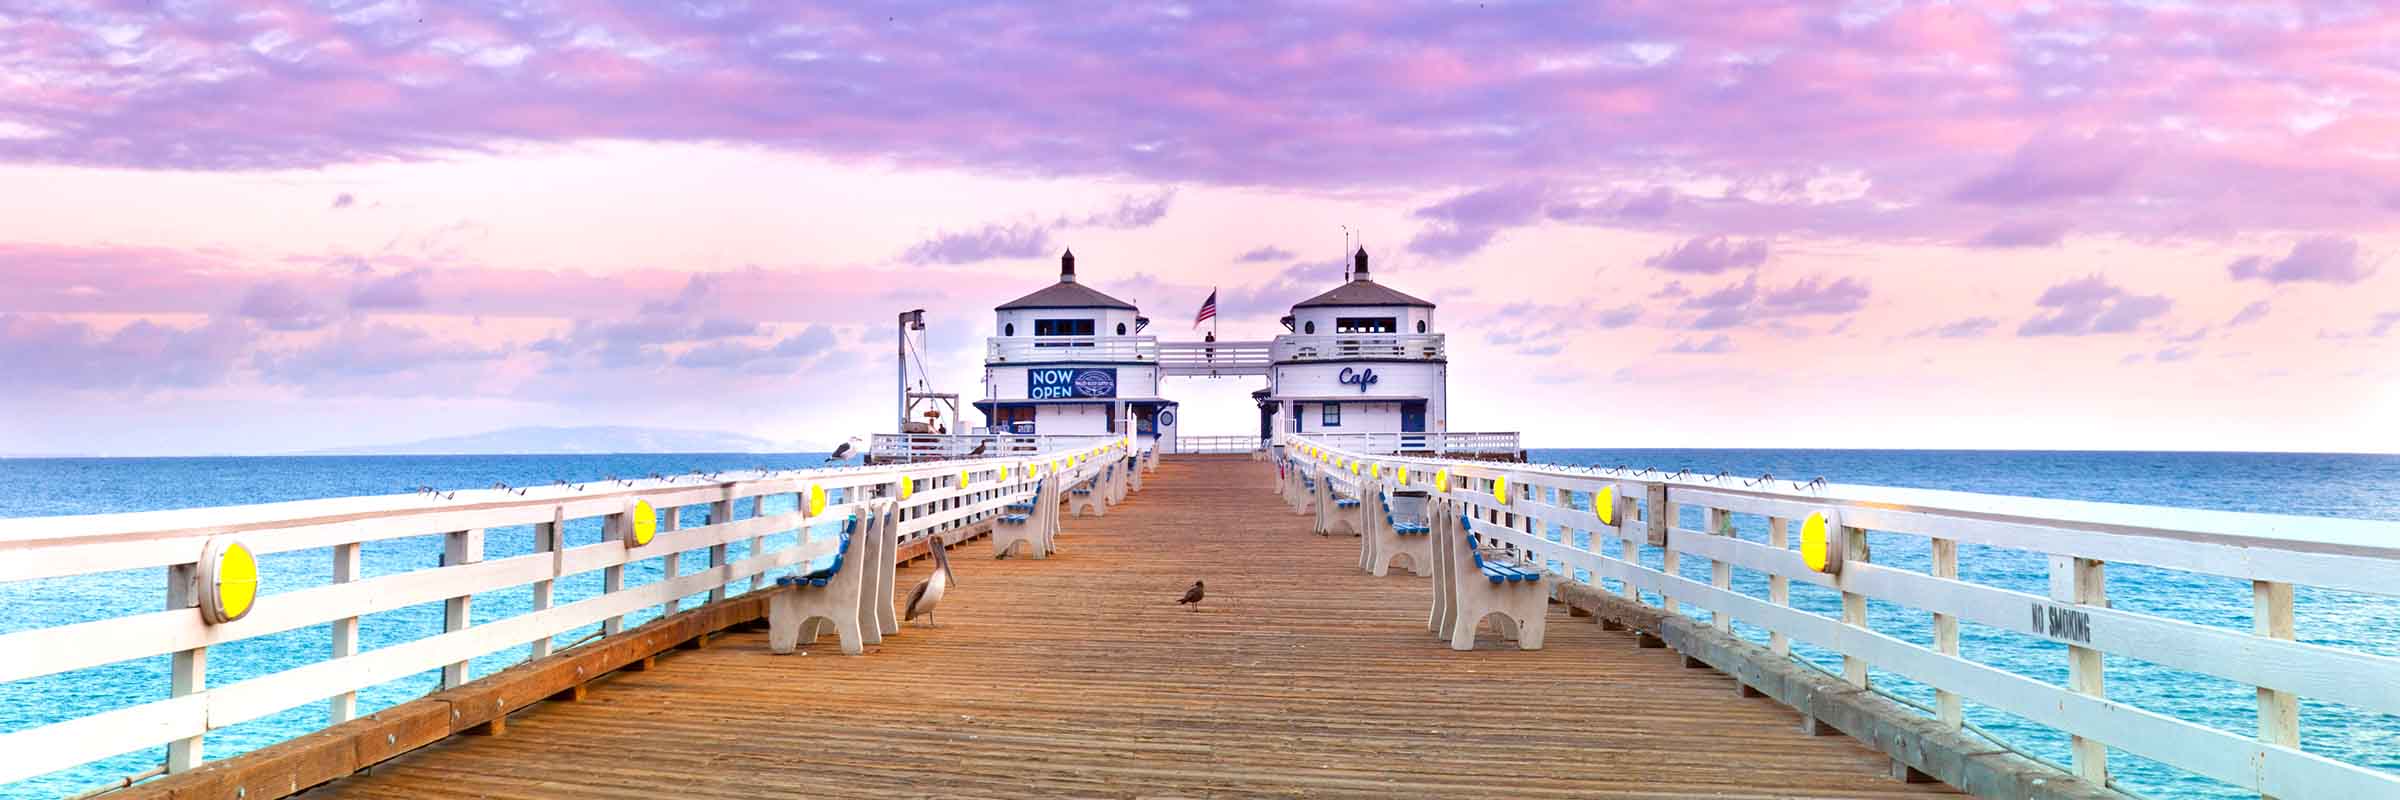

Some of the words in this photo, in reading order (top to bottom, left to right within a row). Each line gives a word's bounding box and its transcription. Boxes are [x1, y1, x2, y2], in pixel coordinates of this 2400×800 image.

[1033, 370, 1073, 385] NOW
[1339, 367, 1378, 392] Cafe
[1032, 386, 1072, 400] OPEN
[2032, 602, 2044, 633] NO
[2049, 605, 2090, 643] SMOKING
